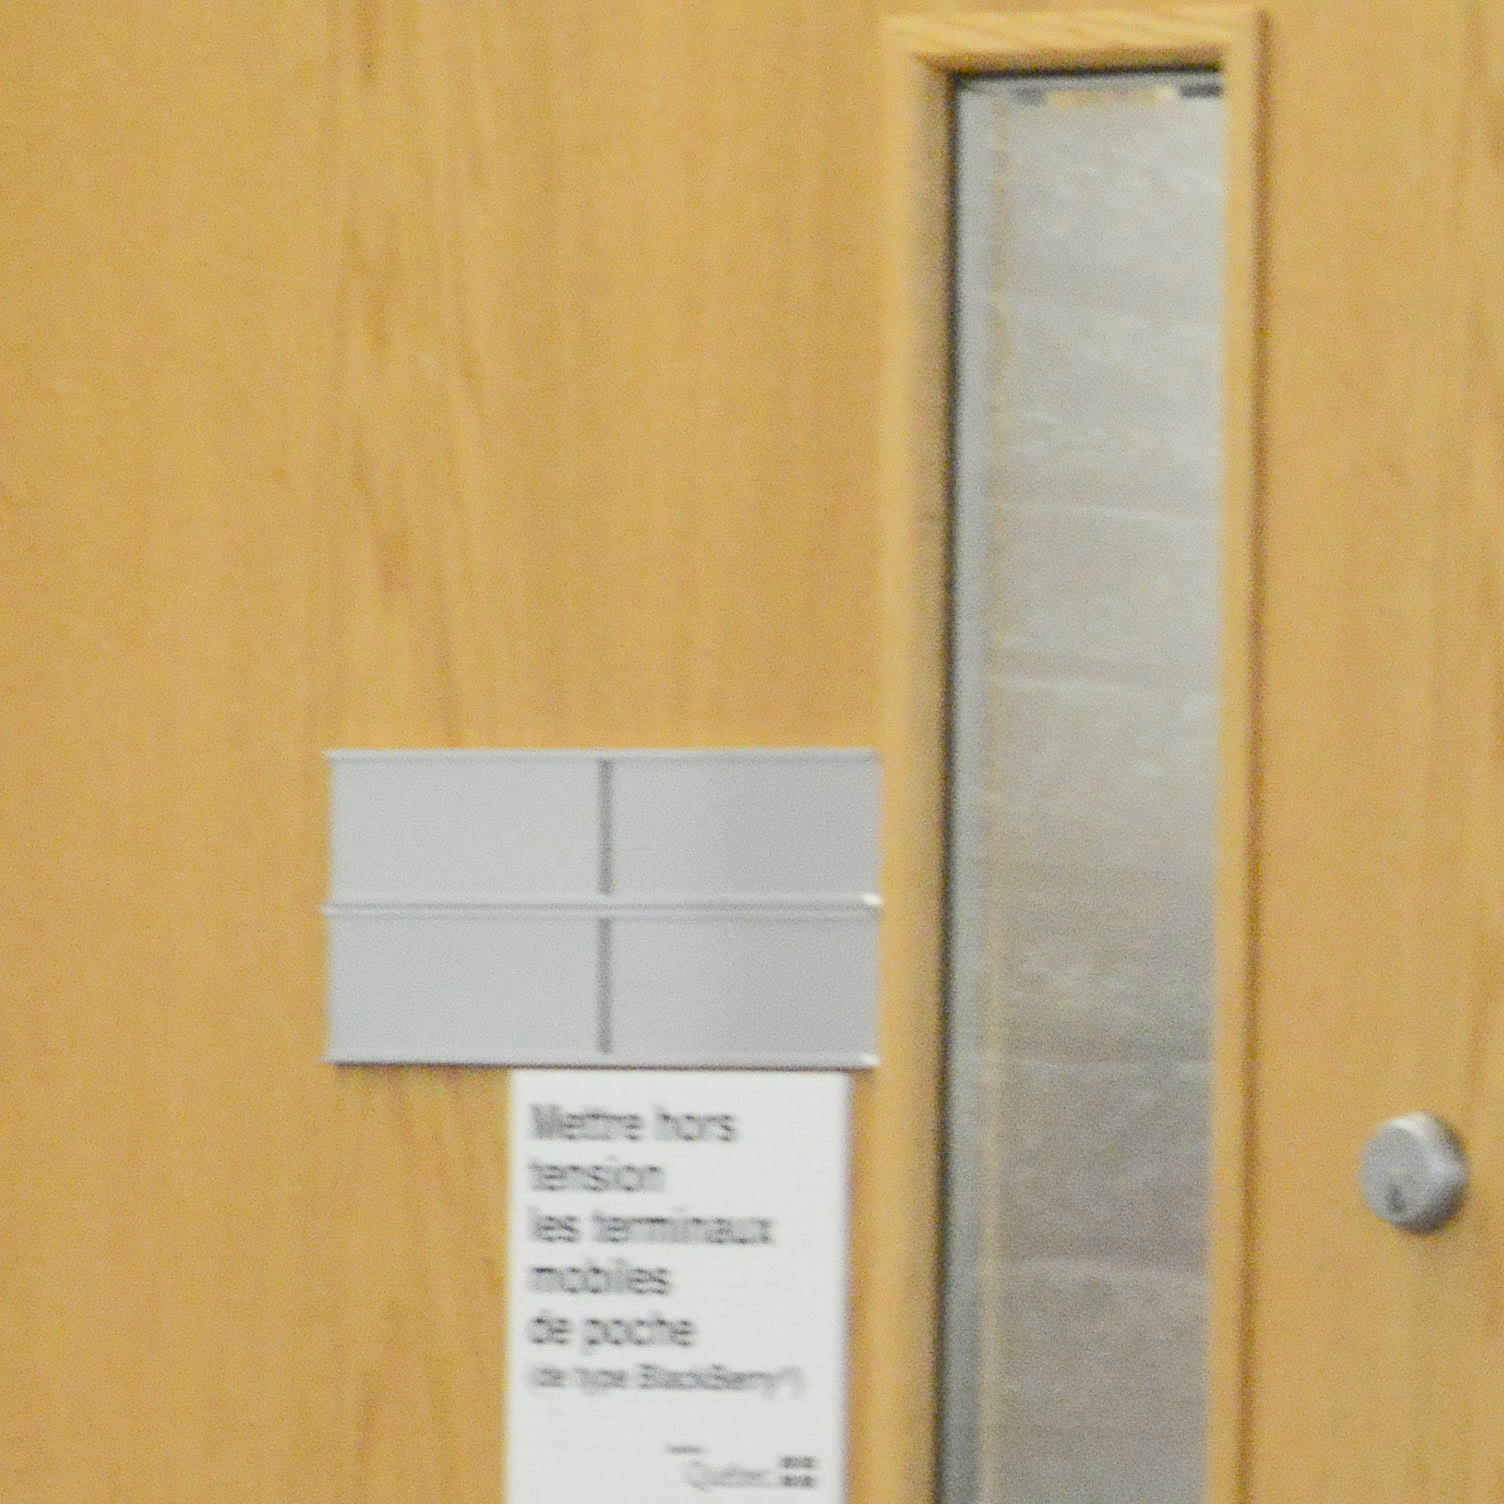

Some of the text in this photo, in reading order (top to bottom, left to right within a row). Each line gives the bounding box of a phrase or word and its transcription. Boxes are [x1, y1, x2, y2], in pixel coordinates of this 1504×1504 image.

[530, 1103, 737, 1142] Mettre hors
[529, 1156, 665, 1192] tension
[528, 1206, 775, 1244] les terminaux
[528, 1258, 671, 1294] mobiles
[528, 1308, 697, 1355] de poche
